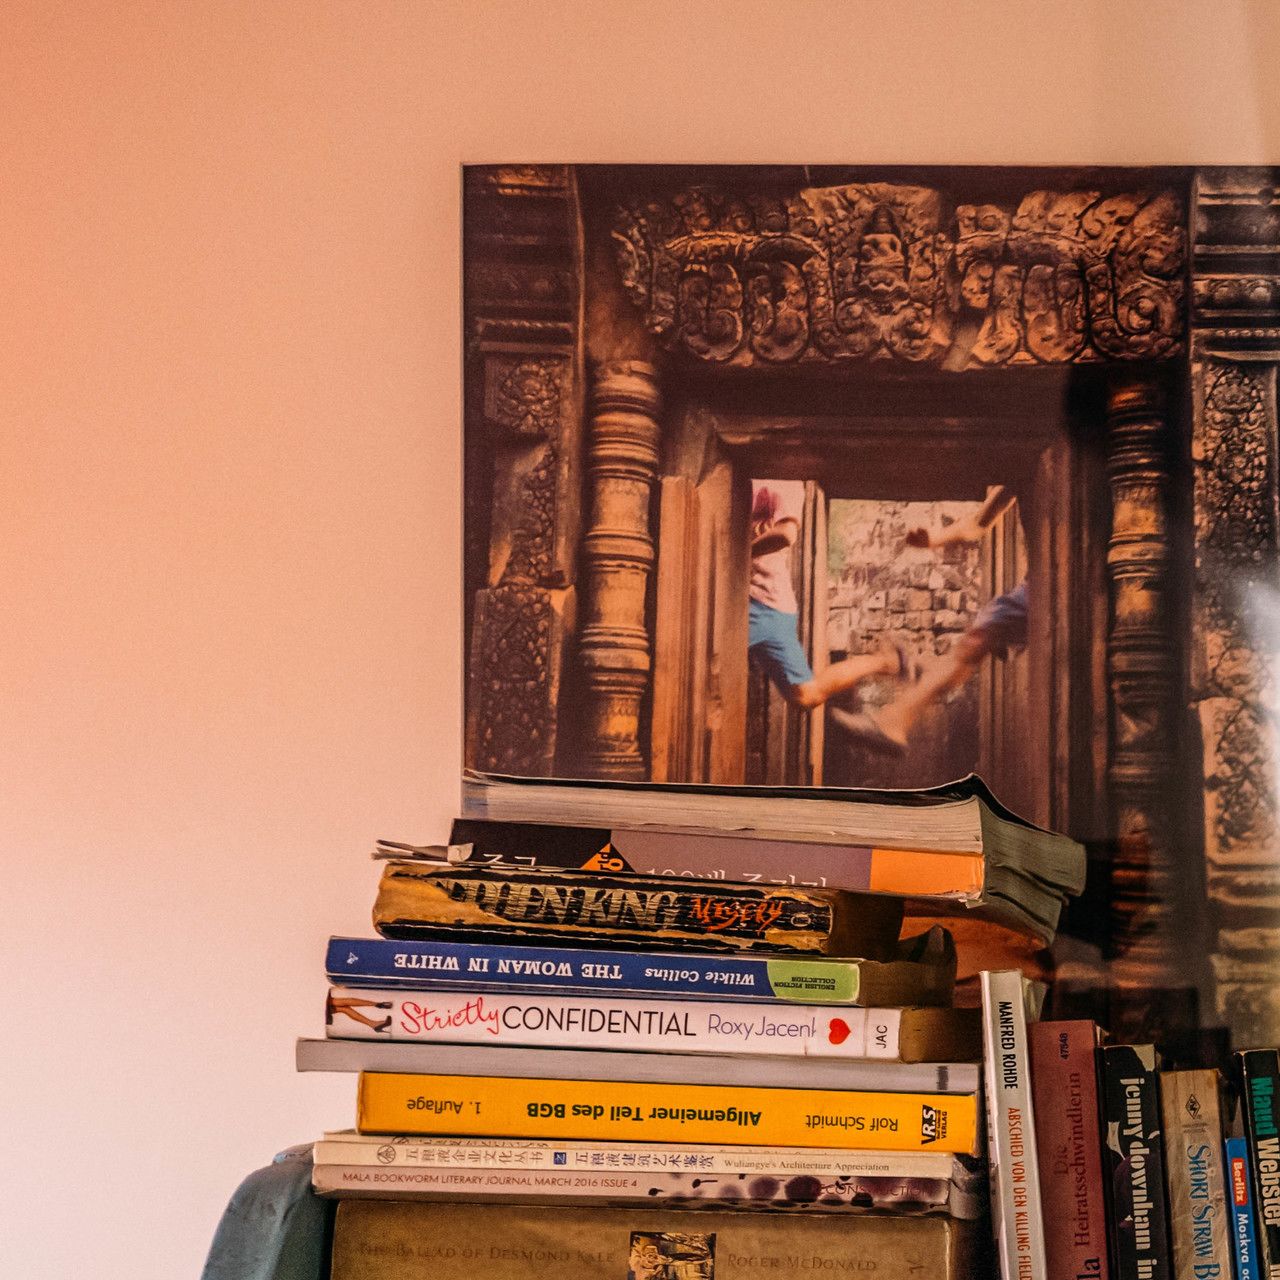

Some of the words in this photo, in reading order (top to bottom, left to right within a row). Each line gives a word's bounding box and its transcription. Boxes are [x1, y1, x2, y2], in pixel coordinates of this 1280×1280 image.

[394, 954, 460, 973] WHITE
[468, 958, 488, 975] IN
[498, 960, 572, 978] WOMAN
[581, 963, 622, 981] THE
[644, 968, 700, 985] Collins
[703, 971, 755, 987] Wilkie
[400, 998, 499, 1041] Strictly
[502, 1005, 697, 1036] CONFIDENTIAL
[708, 1014, 752, 1039] Roxy
[998, 1001, 1017, 1050] MANFRED
[876, 1024, 889, 1048] JAC
[1000, 1052, 1019, 1089] ROHDE
[406, 1097, 463, 1115] Auflage
[467, 1101, 481, 1115] 1.
[524, 1103, 564, 1121] BGB
[569, 1104, 603, 1122] des
[608, 1106, 642, 1124] Teil
[1250, 1075, 1279, 1136] Maud
[648, 1103, 761, 1128] Allgemeiner
[804, 1114, 865, 1132] Schmidt
[869, 1117, 898, 1132] Rolf
[1006, 1107, 1027, 1157] ABSCHIED
[1011, 1160, 1027, 1181] VON
[1232, 1161, 1247, 1204] Berlitz
[1013, 1186, 1030, 1208] DEN
[1014, 1211, 1032, 1252] KILLING
[1236, 1213, 1253, 1263] Moskva
